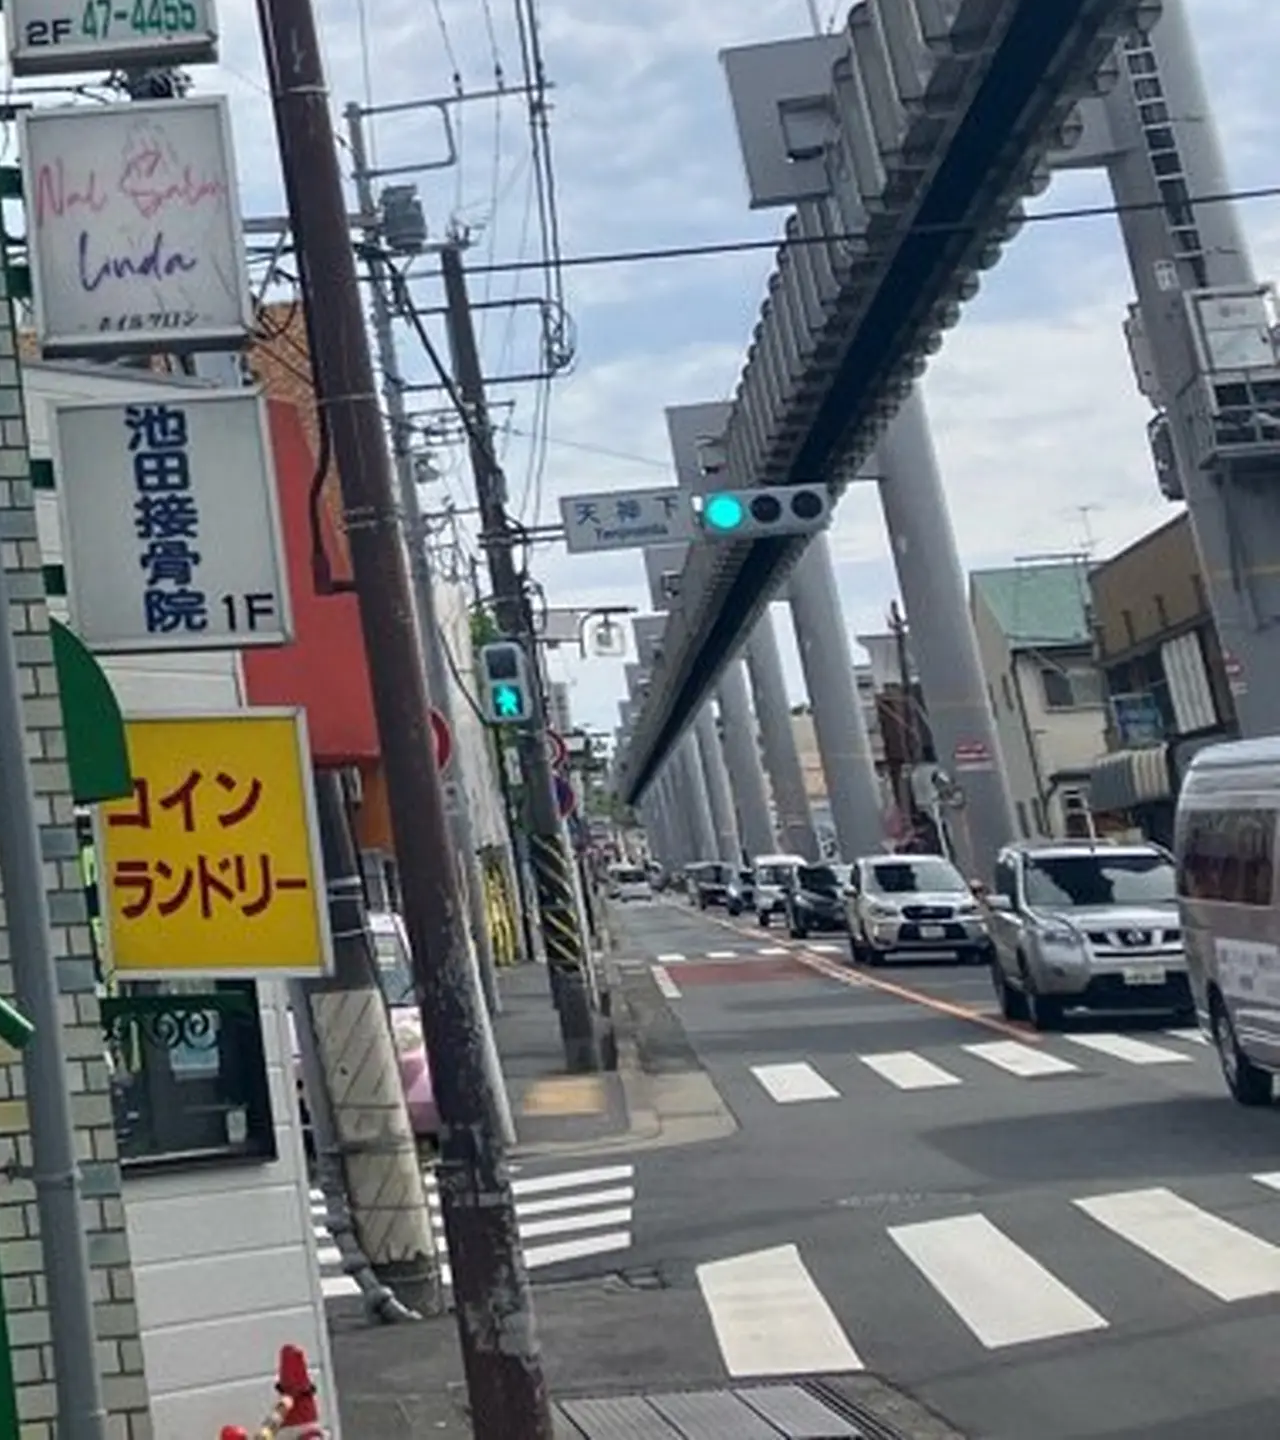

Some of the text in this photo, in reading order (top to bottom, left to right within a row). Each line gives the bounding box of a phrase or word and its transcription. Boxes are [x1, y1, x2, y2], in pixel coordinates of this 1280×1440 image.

[25, 18, 73, 47] 2F
[124, 404, 208, 633] 池田接骨院
[221, 592, 274, 632] 1F
[107, 769, 263, 832] コイン
[113, 854, 308, 919] ランドリー
